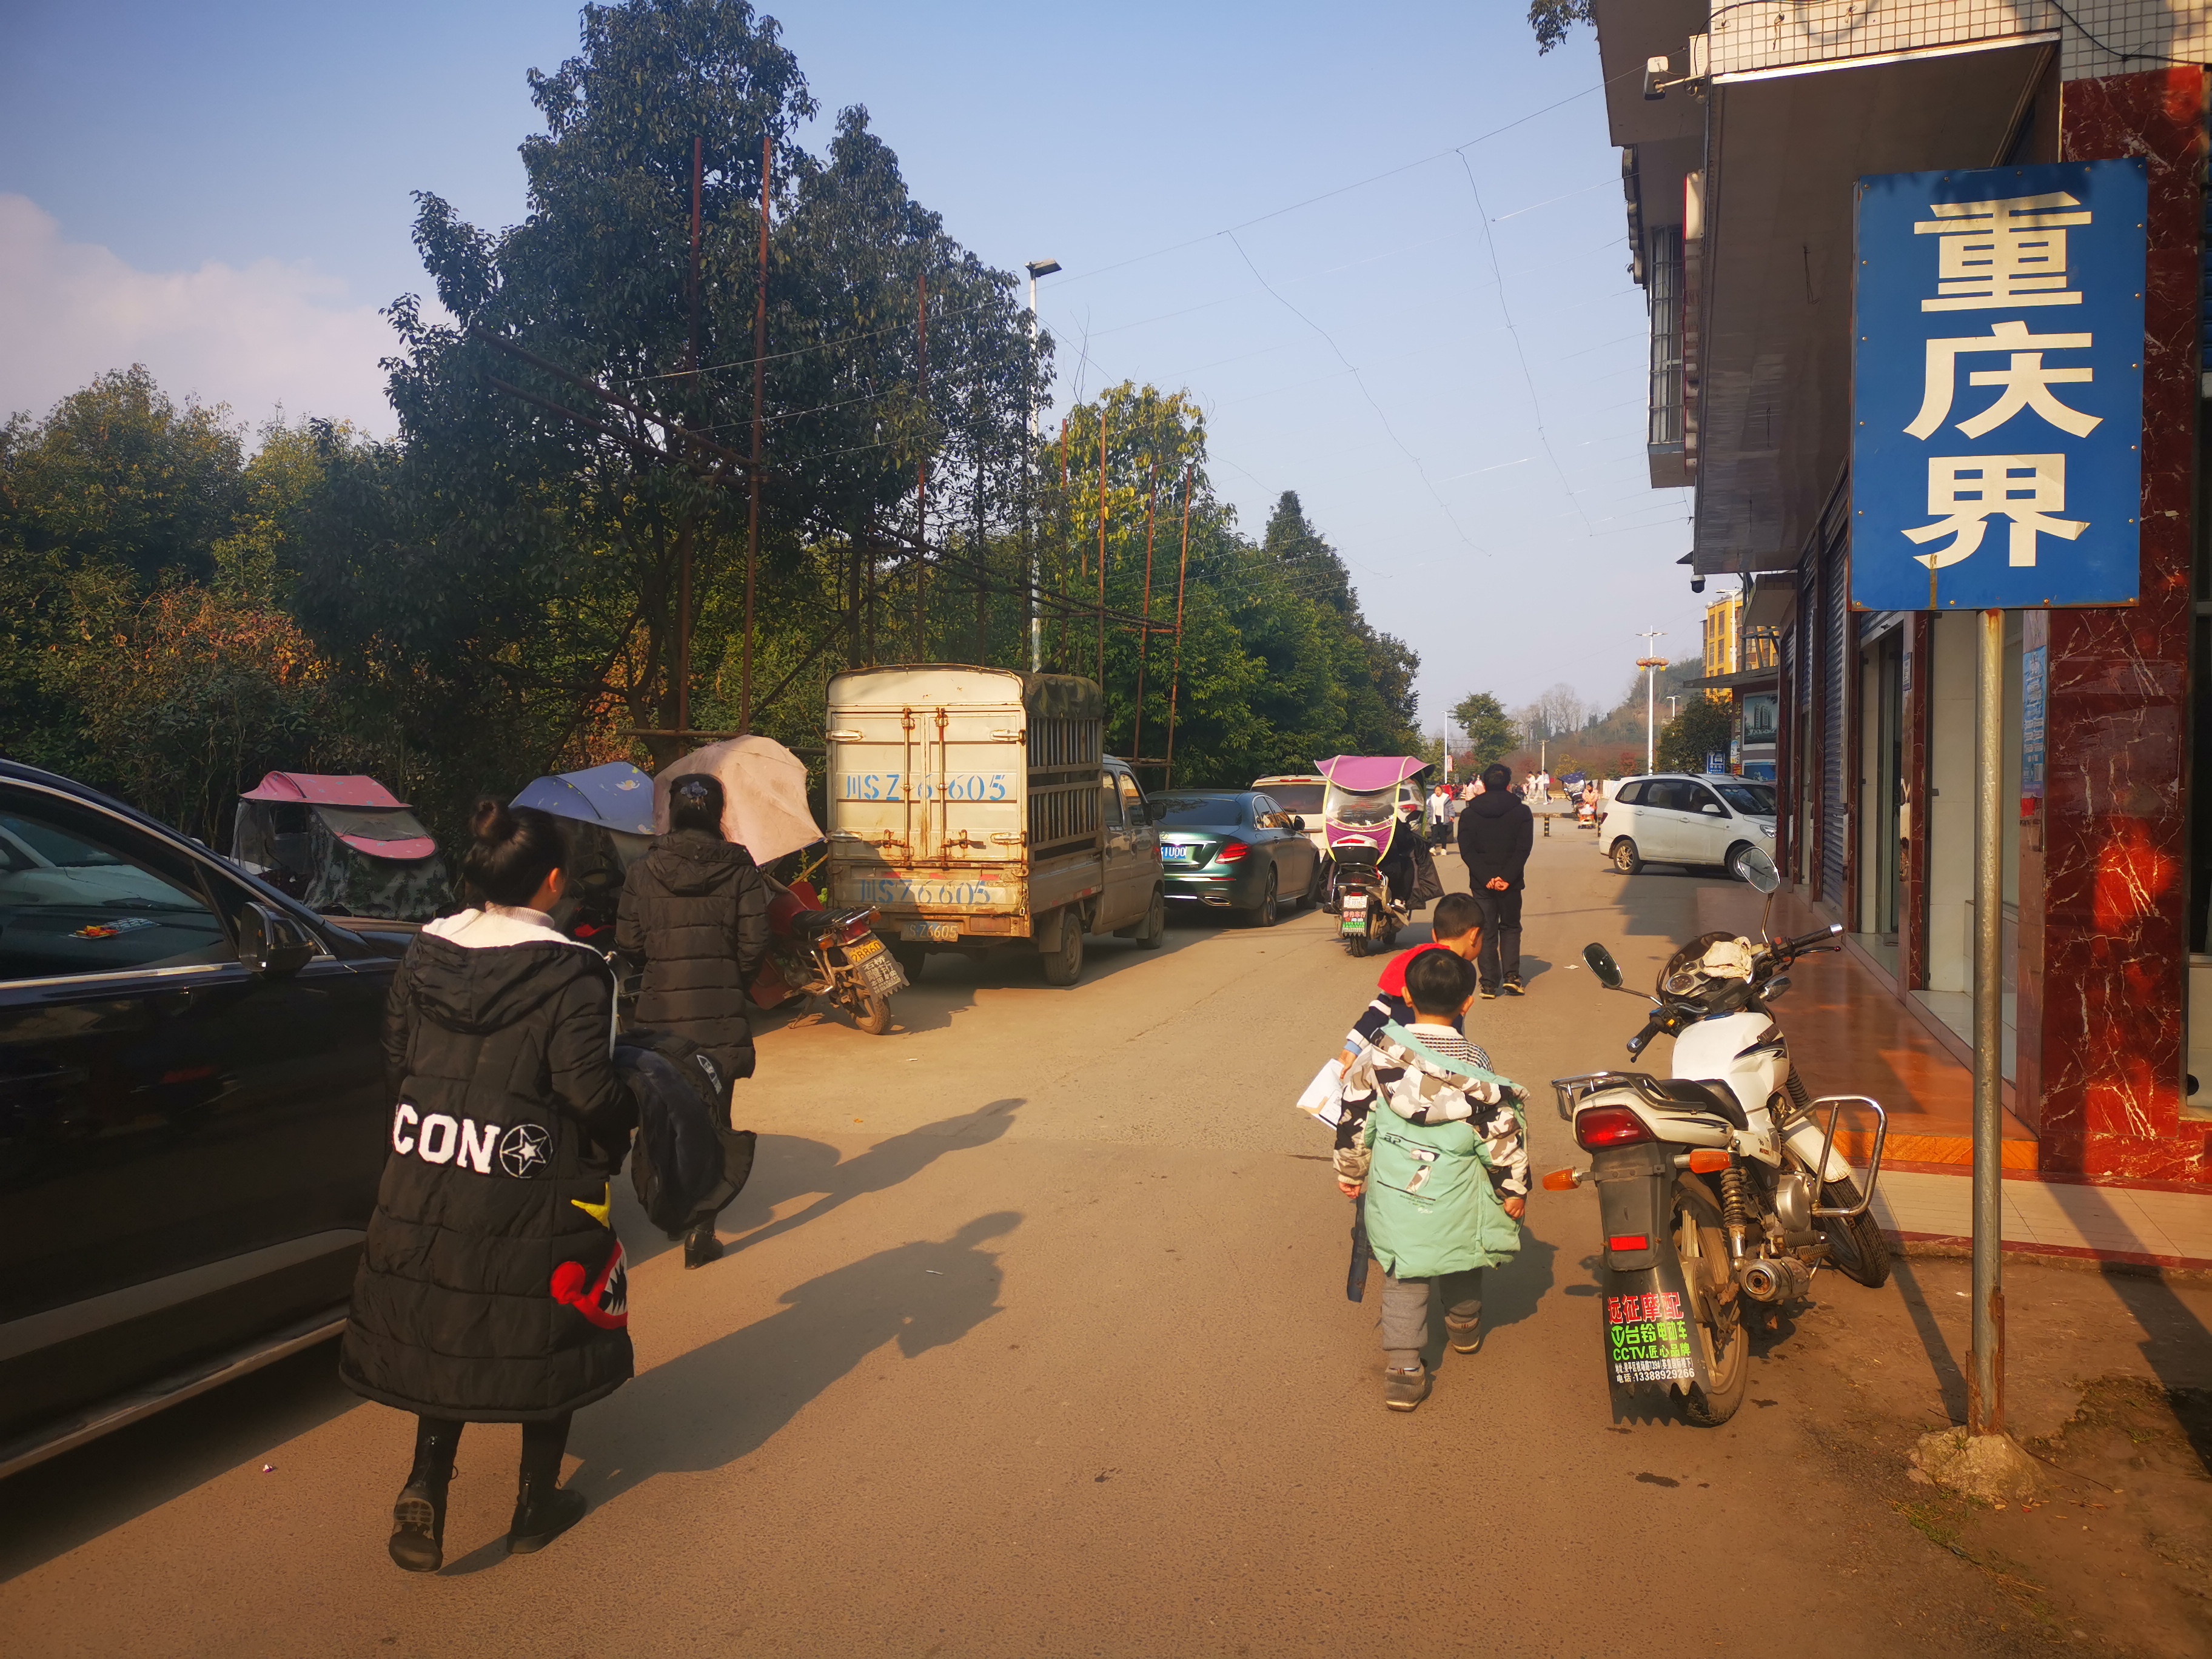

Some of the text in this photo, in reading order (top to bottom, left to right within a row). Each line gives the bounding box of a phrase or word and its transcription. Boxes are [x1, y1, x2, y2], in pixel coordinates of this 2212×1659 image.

[1901, 191, 2104, 569] 重庆界
[394, 1104, 501, 1174] CON
[1607, 1292, 1684, 1325] 远征摩配
